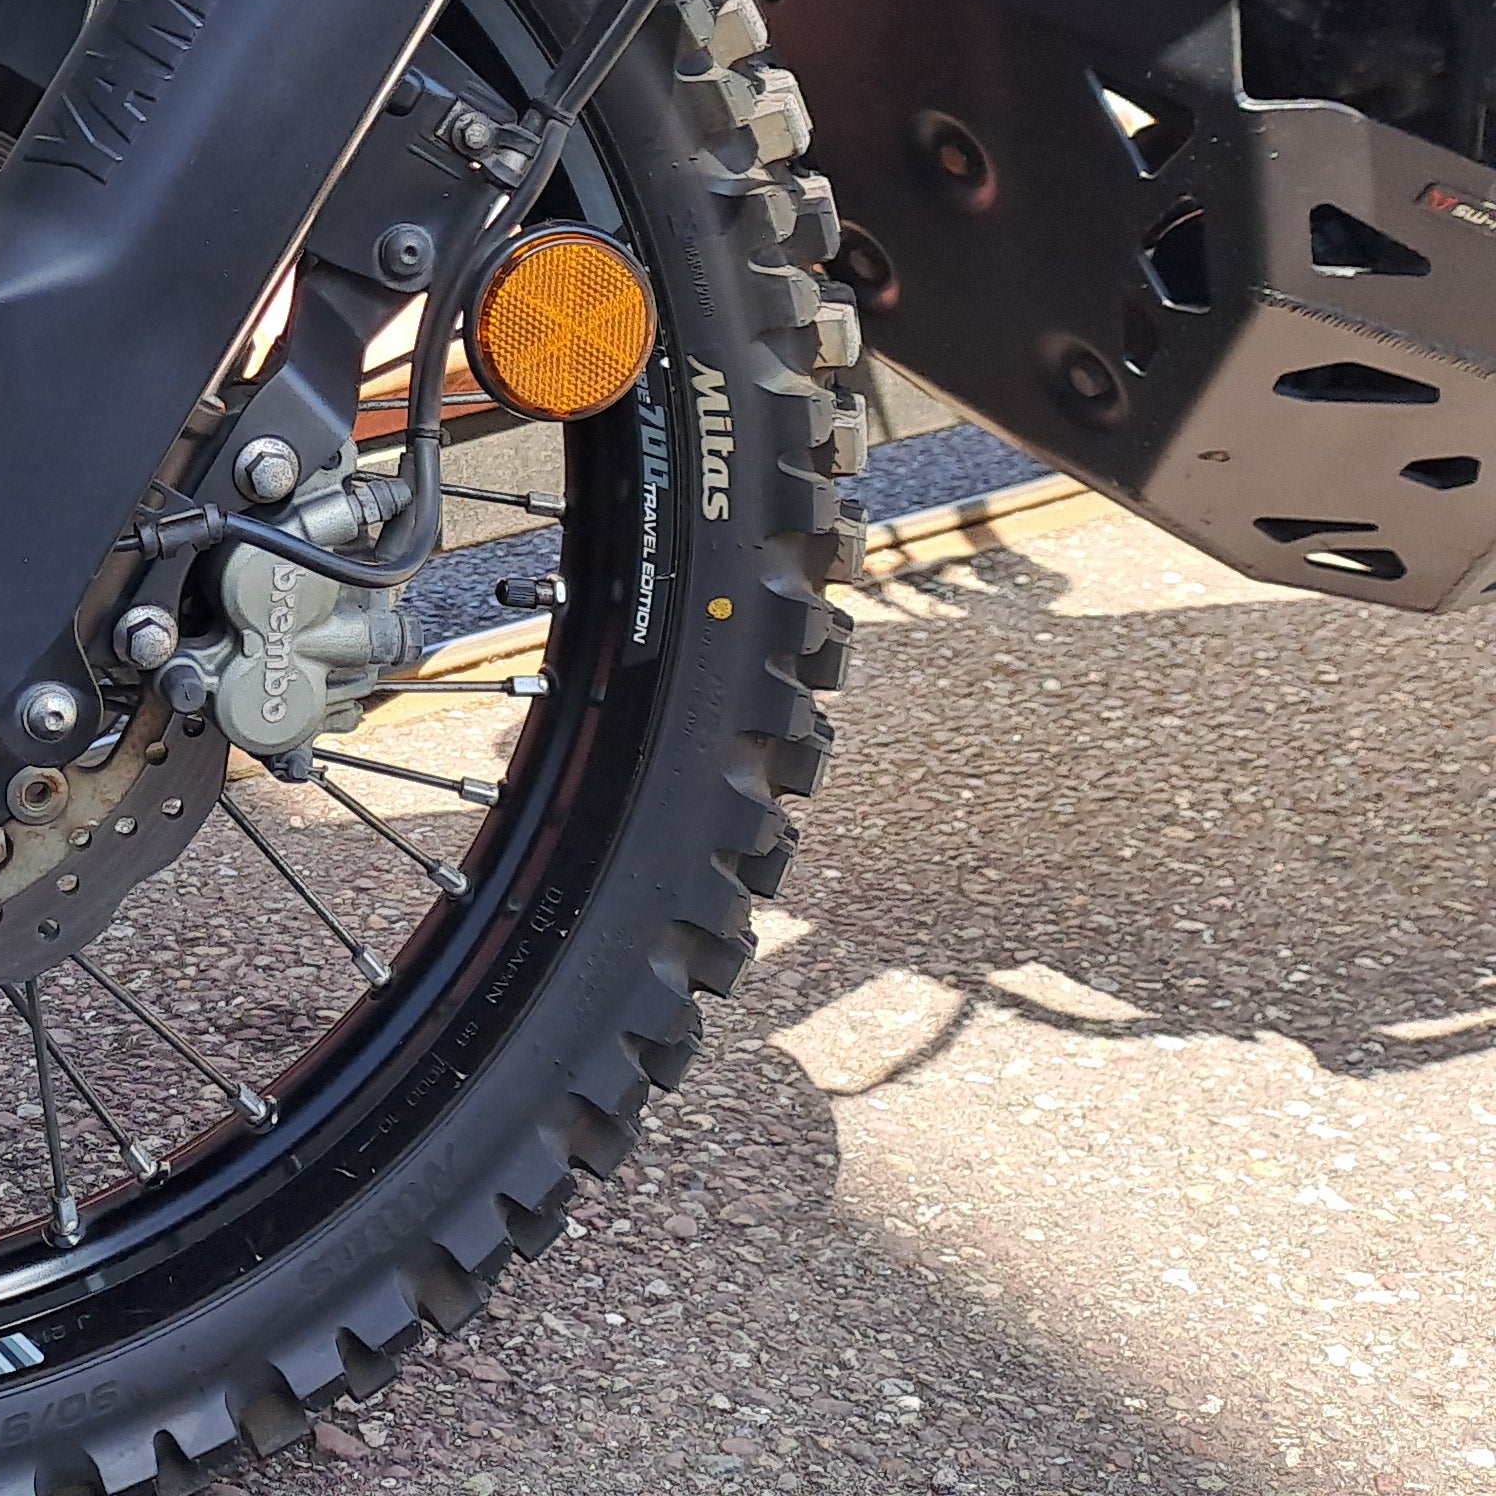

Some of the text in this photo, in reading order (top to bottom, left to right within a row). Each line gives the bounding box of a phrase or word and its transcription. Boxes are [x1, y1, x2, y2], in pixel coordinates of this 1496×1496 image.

[638, 403, 671, 491] 700
[686, 354, 736, 522] Mitas
[641, 481, 660, 561] TRAVEL
[260, 563, 307, 724] brembo
[632, 562, 657, 646] EDITION
